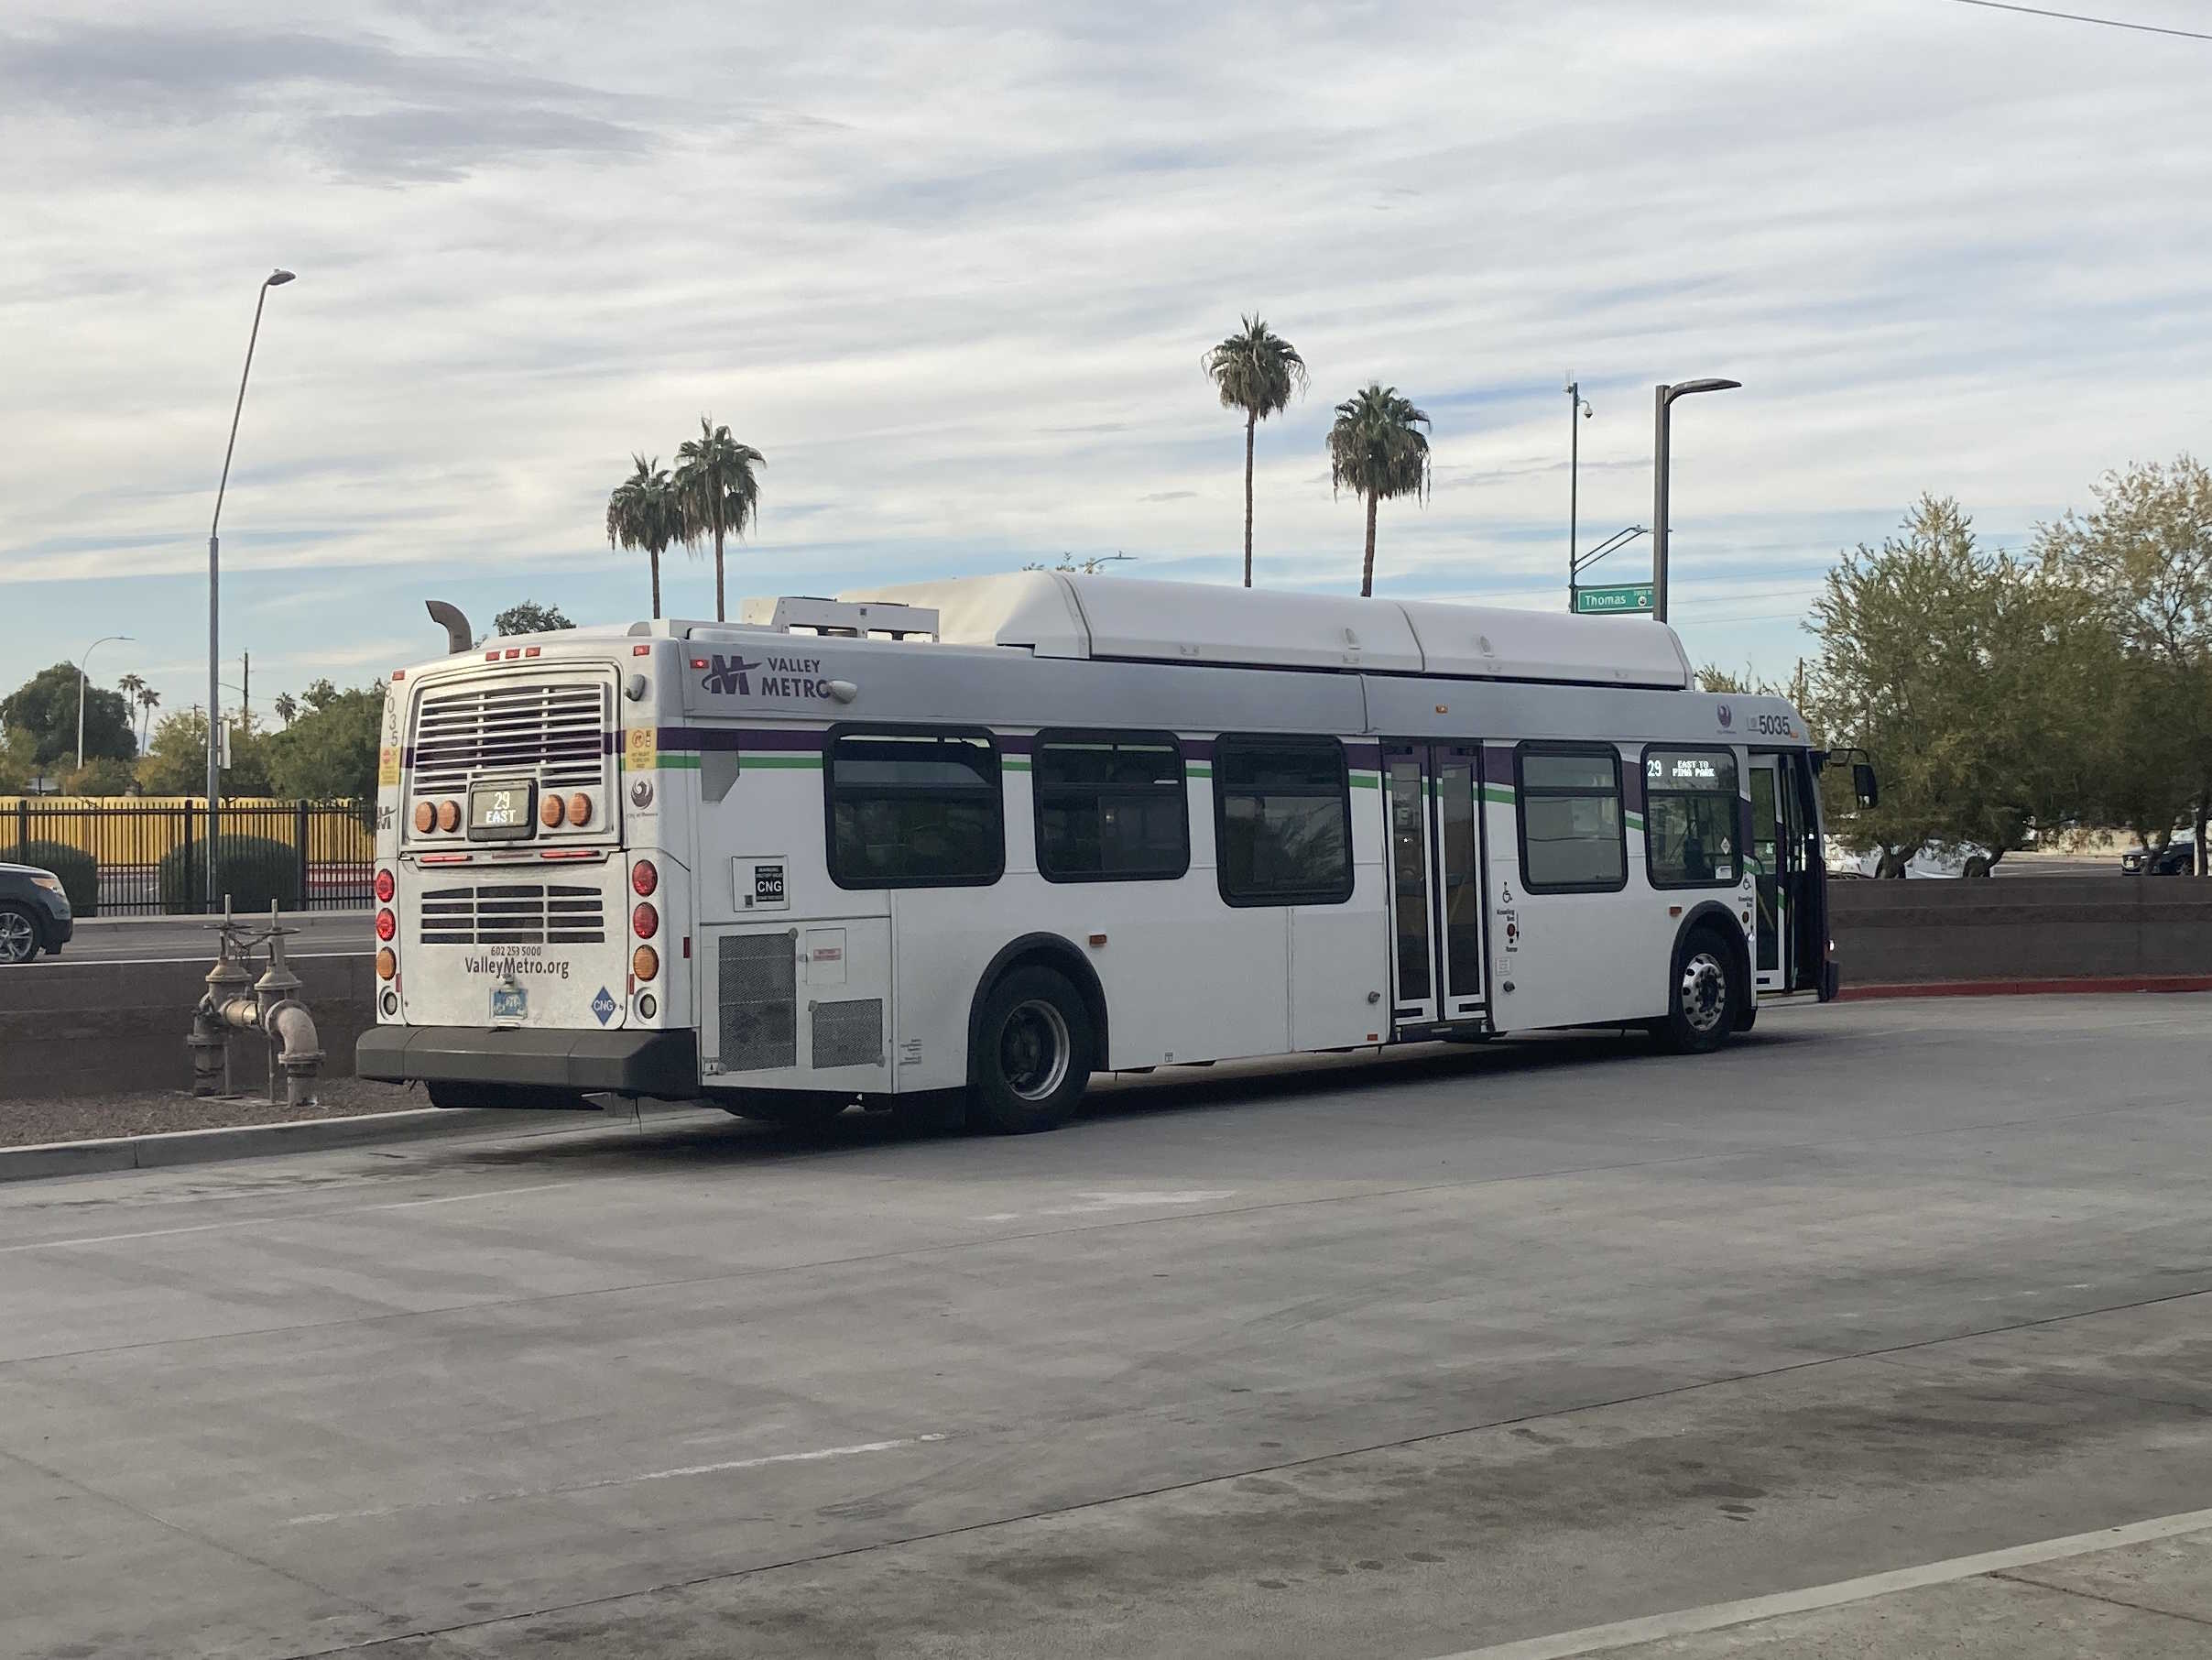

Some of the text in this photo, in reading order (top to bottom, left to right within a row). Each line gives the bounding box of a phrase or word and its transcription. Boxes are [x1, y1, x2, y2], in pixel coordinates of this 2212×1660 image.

[1585, 595, 1627, 606] Thomas
[768, 657, 821, 673] VALLEY
[1759, 715, 1791, 736] 5035
[1647, 759, 1662, 777] 29
[1677, 760, 1709, 769] EAST TO
[1672, 768, 1716, 777] PIMA PARK
[494, 791, 511, 810] 29
[485, 809, 517, 824] EAST
[757, 880, 782, 892] CNG
[491, 945, 541, 956] 602 253 5000
[464, 956, 569, 979] ValleyMetro.org
[593, 999, 614, 1011] CNG
